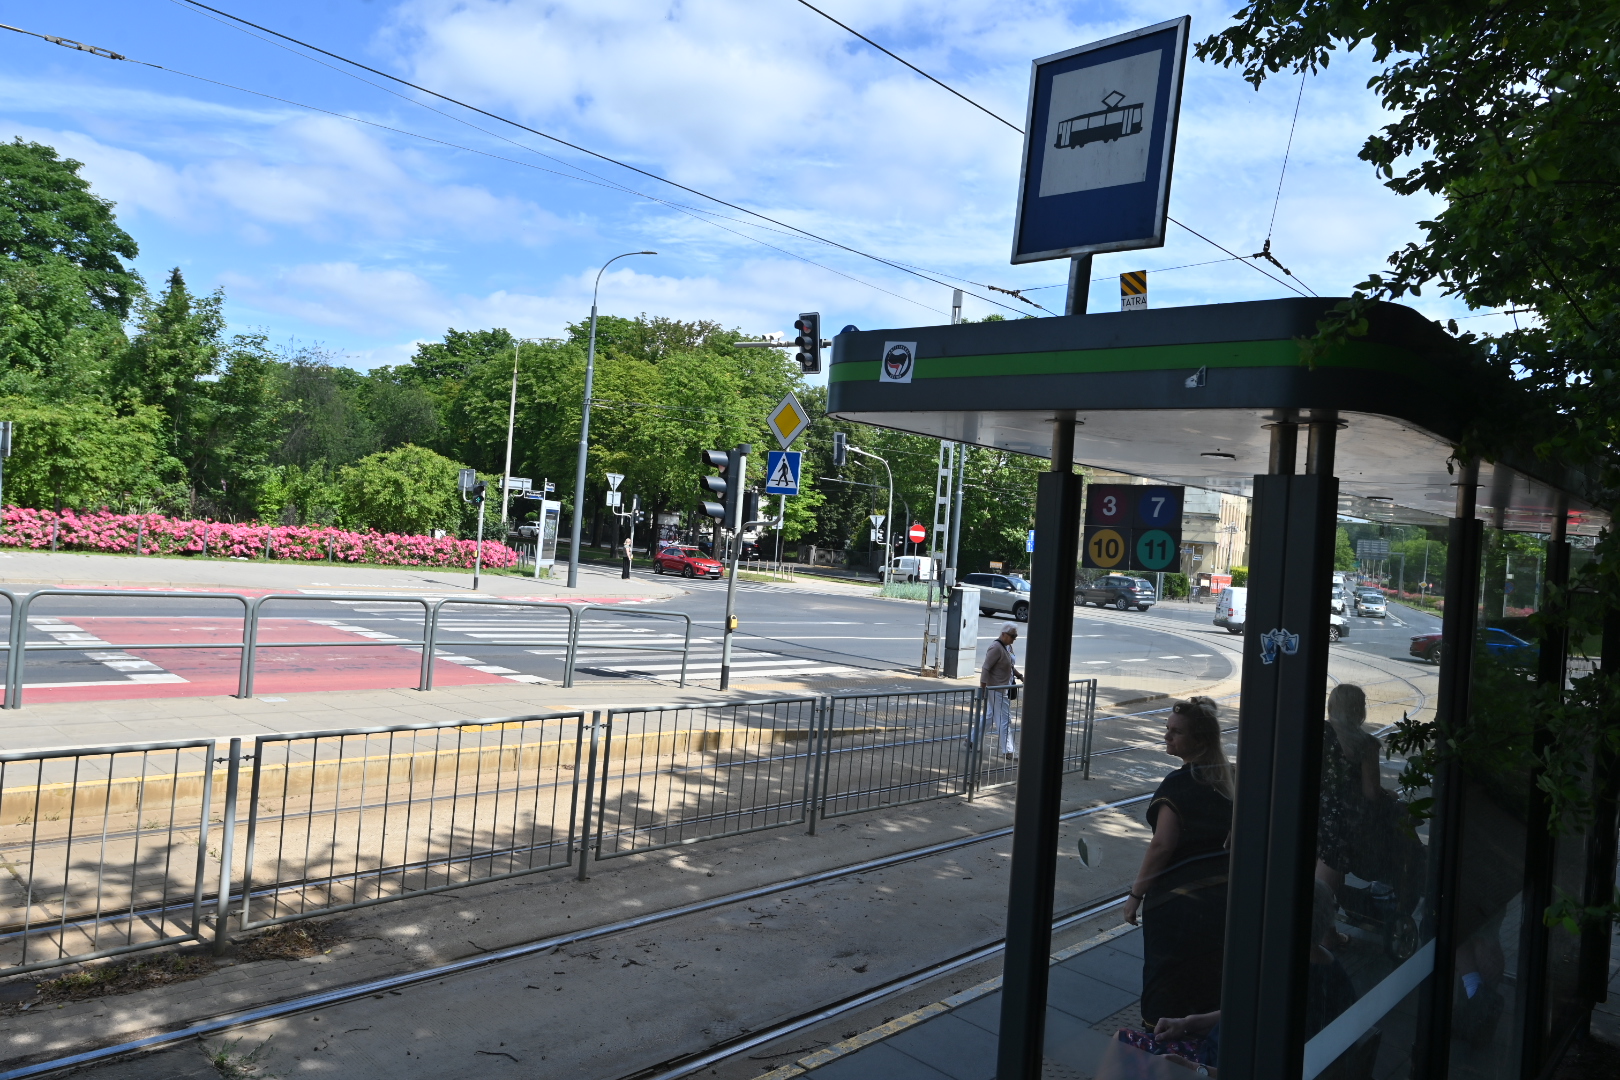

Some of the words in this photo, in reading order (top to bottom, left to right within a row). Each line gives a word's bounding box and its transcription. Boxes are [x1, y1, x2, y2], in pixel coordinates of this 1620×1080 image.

[1121, 296, 1147, 307] TATRA
[1102, 495, 1117, 516] 3
[1151, 497, 1165, 518] 7
[1093, 538, 1120, 559] 10
[1144, 539, 1167, 560] 11
